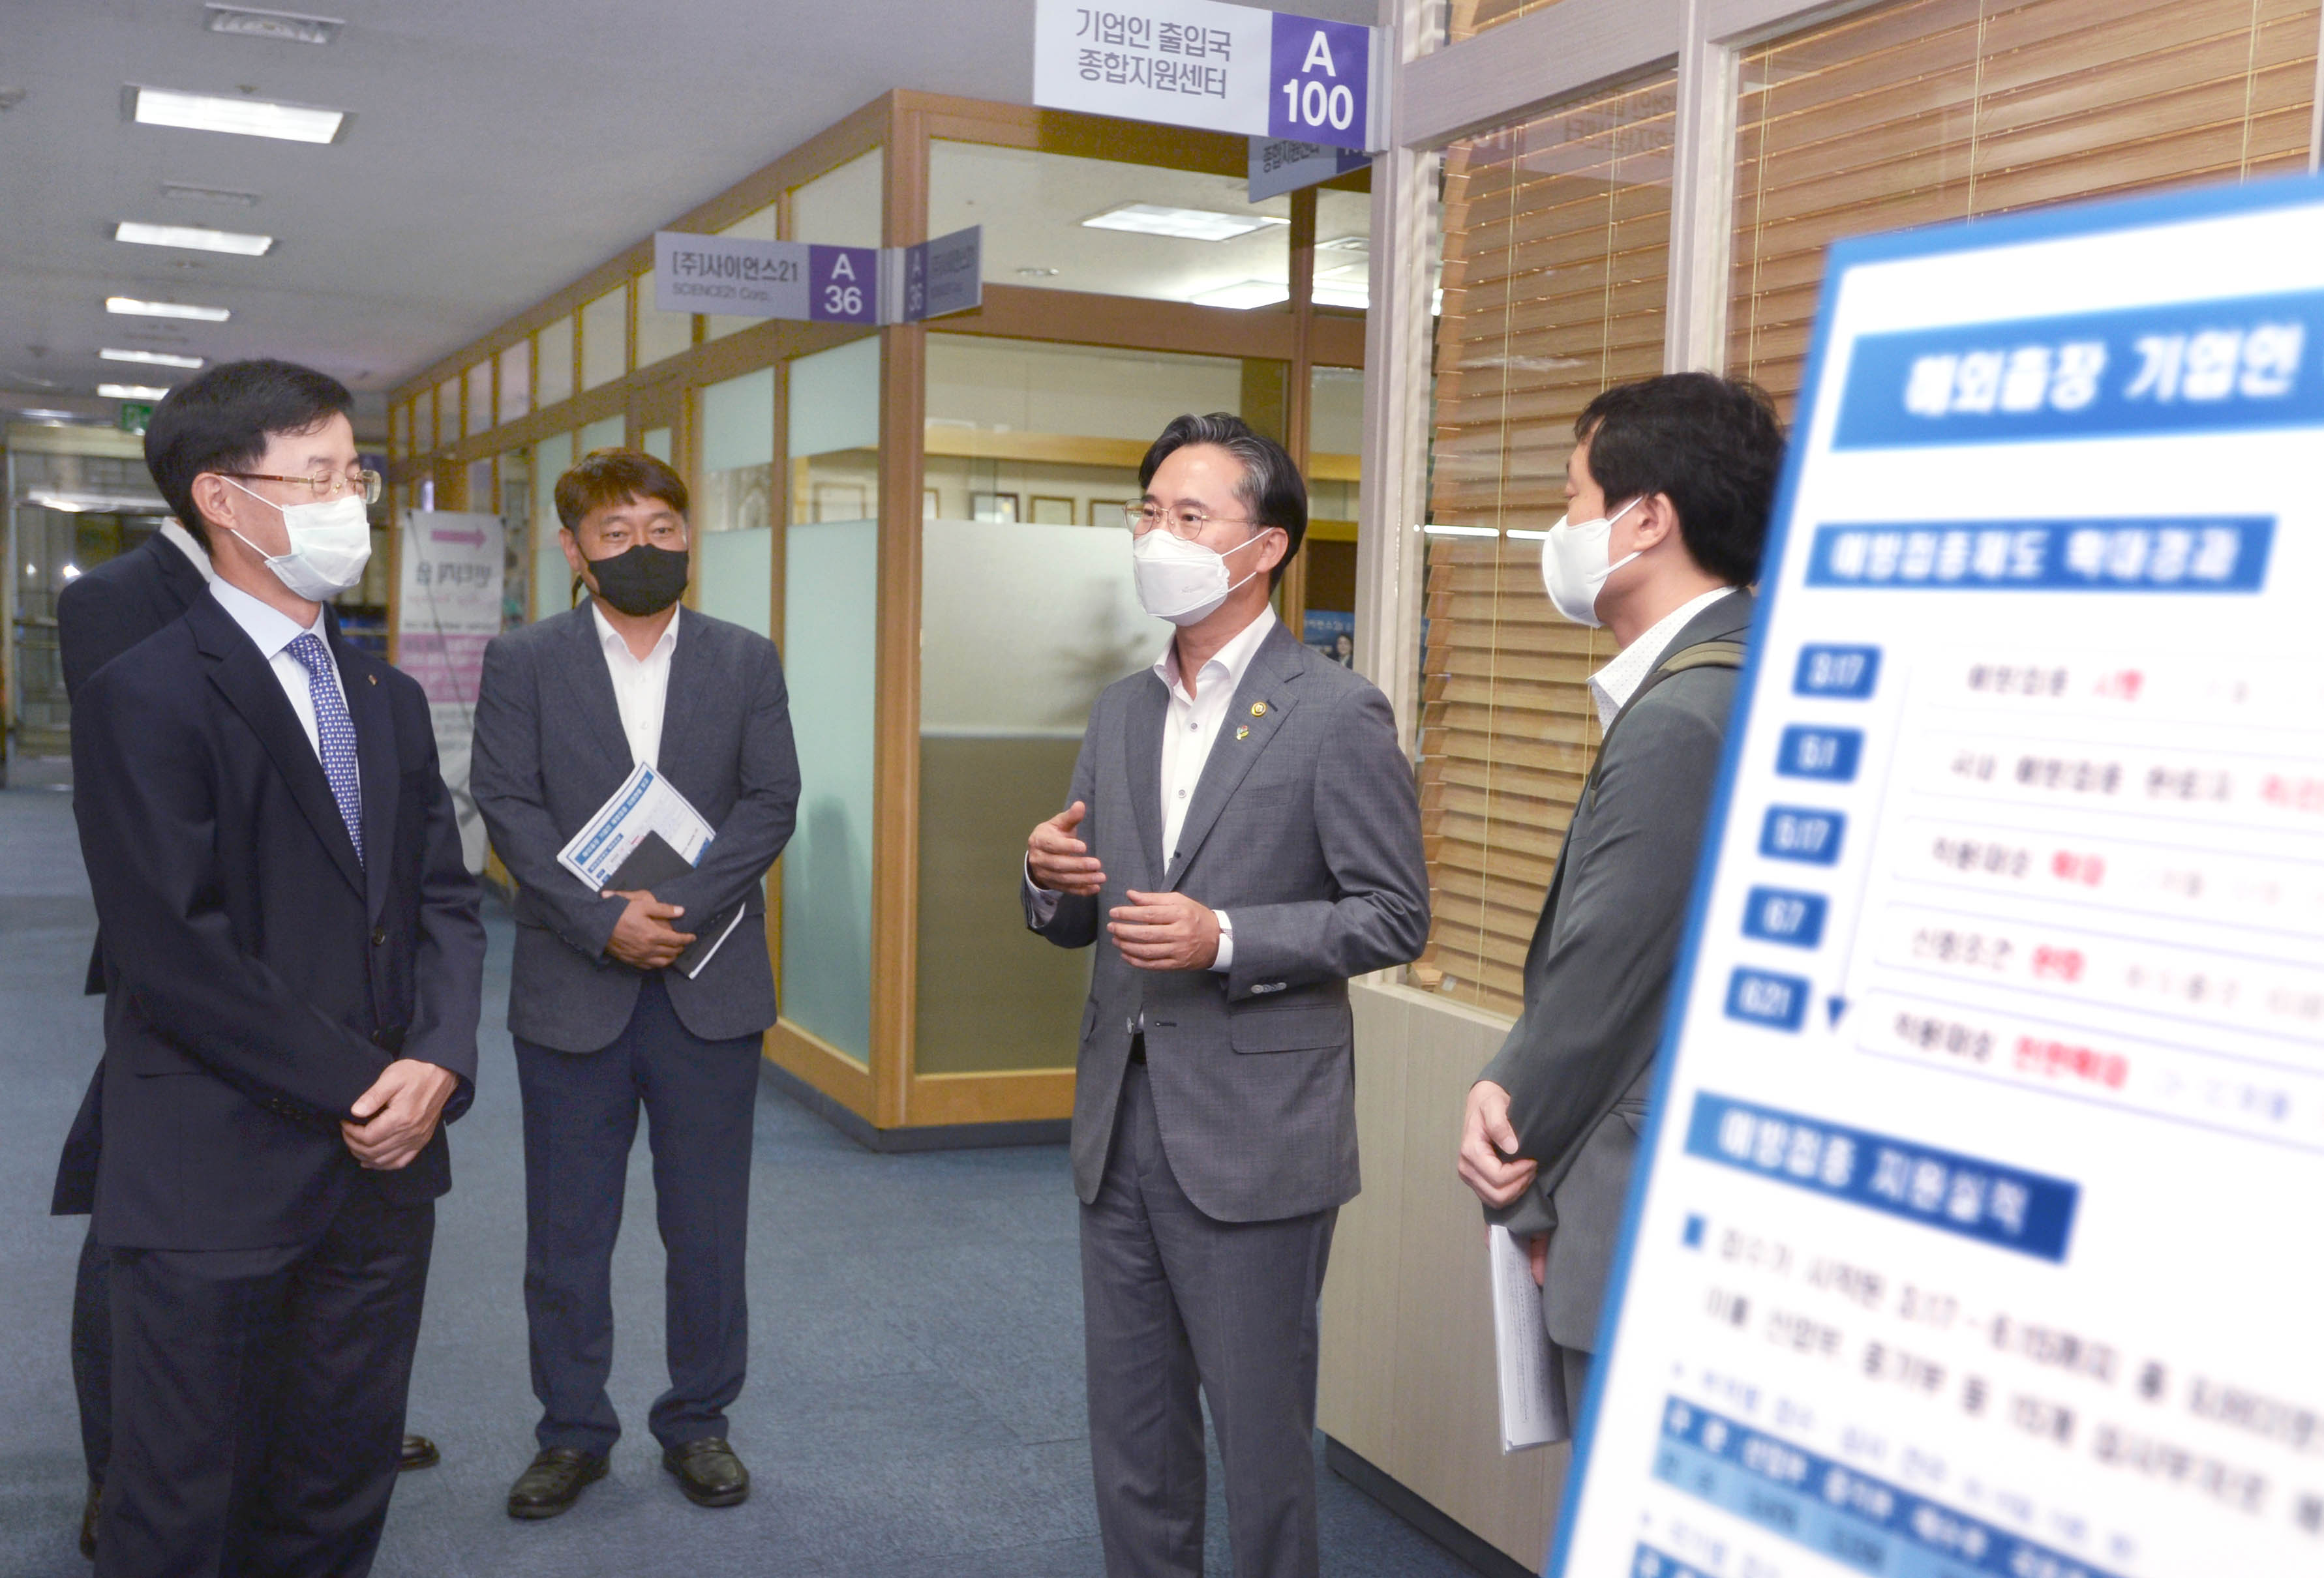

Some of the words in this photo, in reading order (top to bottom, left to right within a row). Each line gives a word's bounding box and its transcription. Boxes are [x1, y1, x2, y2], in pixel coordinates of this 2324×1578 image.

[1076, 8, 1151, 50] 기업인
[1158, 22, 1232, 62] 출입국
[1302, 31, 1336, 77] A
[1078, 48, 1227, 99] 종합지원센터
[1282, 78, 1353, 130] 100
[831, 254, 856, 281] A
[824, 285, 863, 316] 36
[2126, 325, 2304, 402] 기업인
